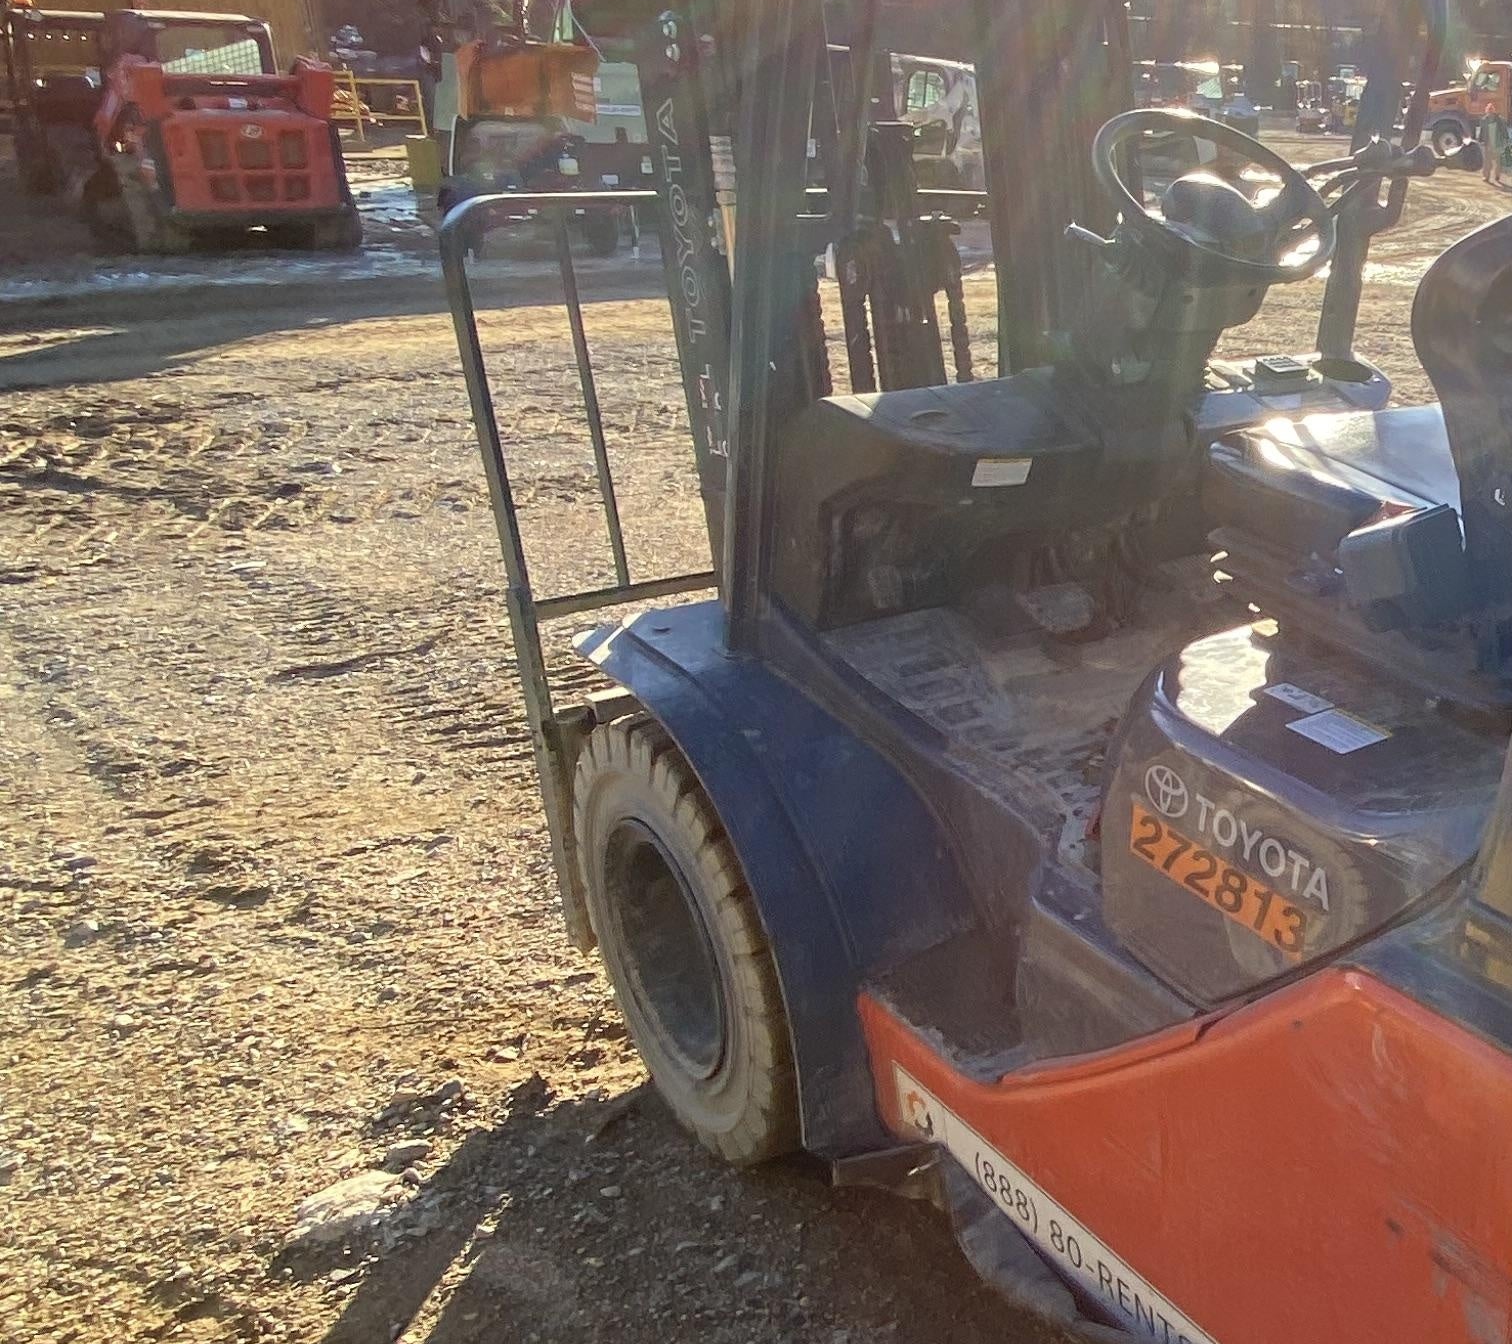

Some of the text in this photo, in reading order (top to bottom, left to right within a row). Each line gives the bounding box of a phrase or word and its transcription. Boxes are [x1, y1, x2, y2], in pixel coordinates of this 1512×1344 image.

[656, 98, 706, 344] TOYOTA
[1133, 815, 1307, 953] 272813
[1195, 793, 1330, 912] TOYOTA
[974, 1152, 1039, 1234] (888)
